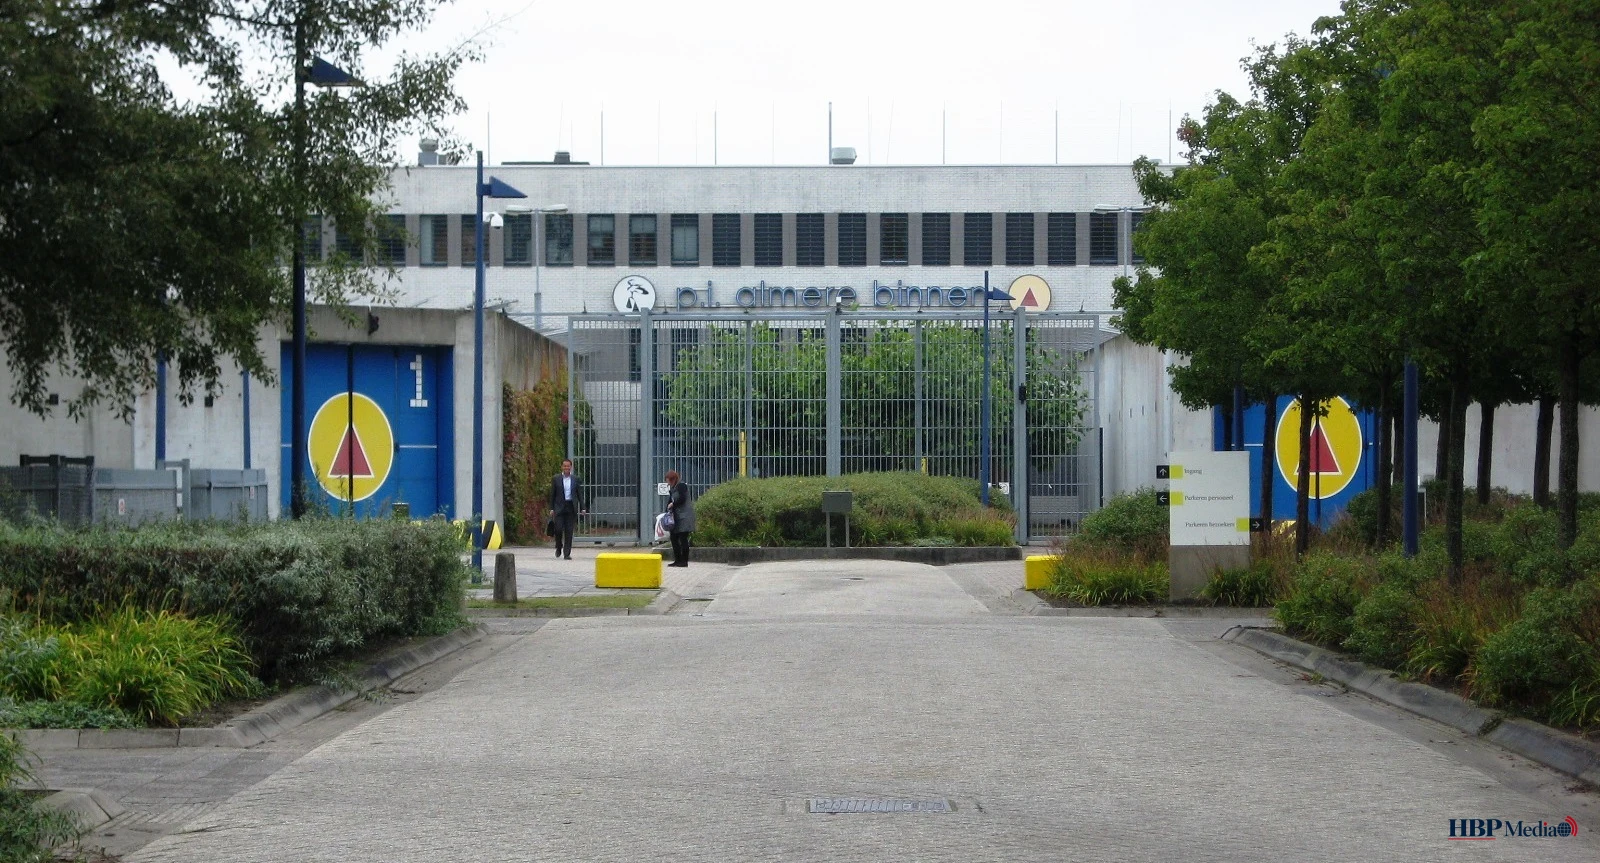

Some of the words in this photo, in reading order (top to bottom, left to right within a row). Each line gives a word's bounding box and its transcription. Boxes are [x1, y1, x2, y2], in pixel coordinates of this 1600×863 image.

[676, 280, 720, 312] p.i.
[735, 280, 857, 307] almere
[873, 279, 987, 307] binnen
[410, 354, 428, 407] 1
